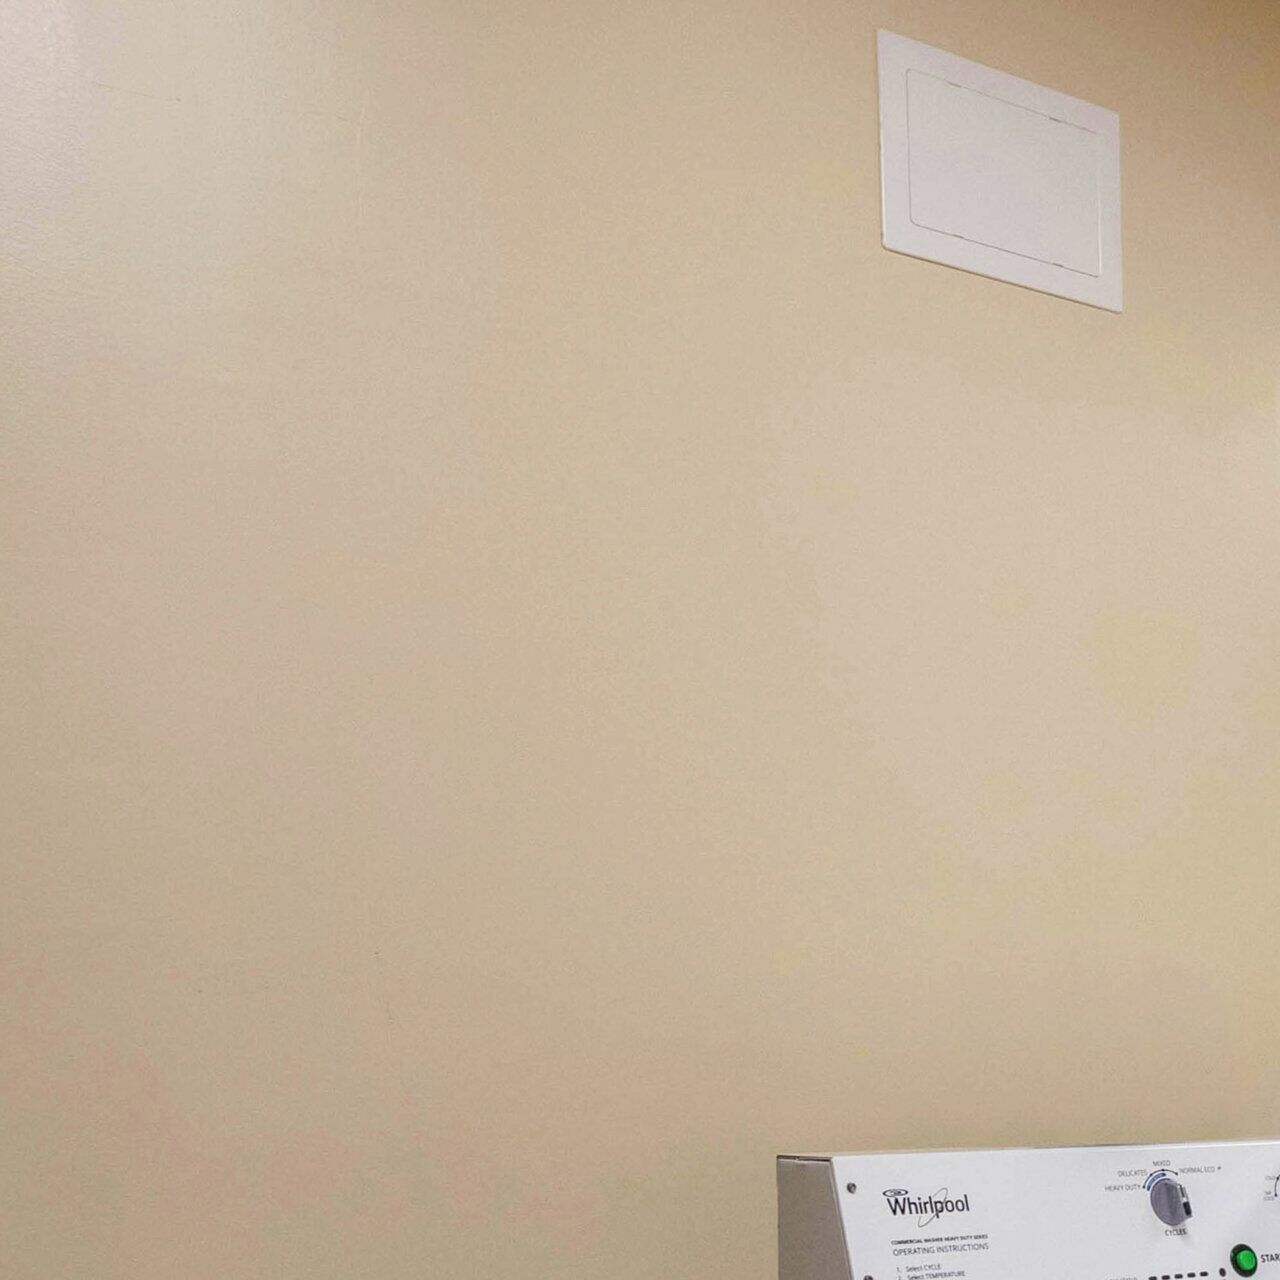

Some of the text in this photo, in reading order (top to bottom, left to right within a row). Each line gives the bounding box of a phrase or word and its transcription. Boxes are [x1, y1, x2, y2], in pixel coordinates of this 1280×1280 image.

[1117, 1169, 1148, 1178] DELICATES
[887, 1194, 970, 1219] Whirlpool
[893, 1243, 989, 1256] OPERATING INSTRUCTIONS
